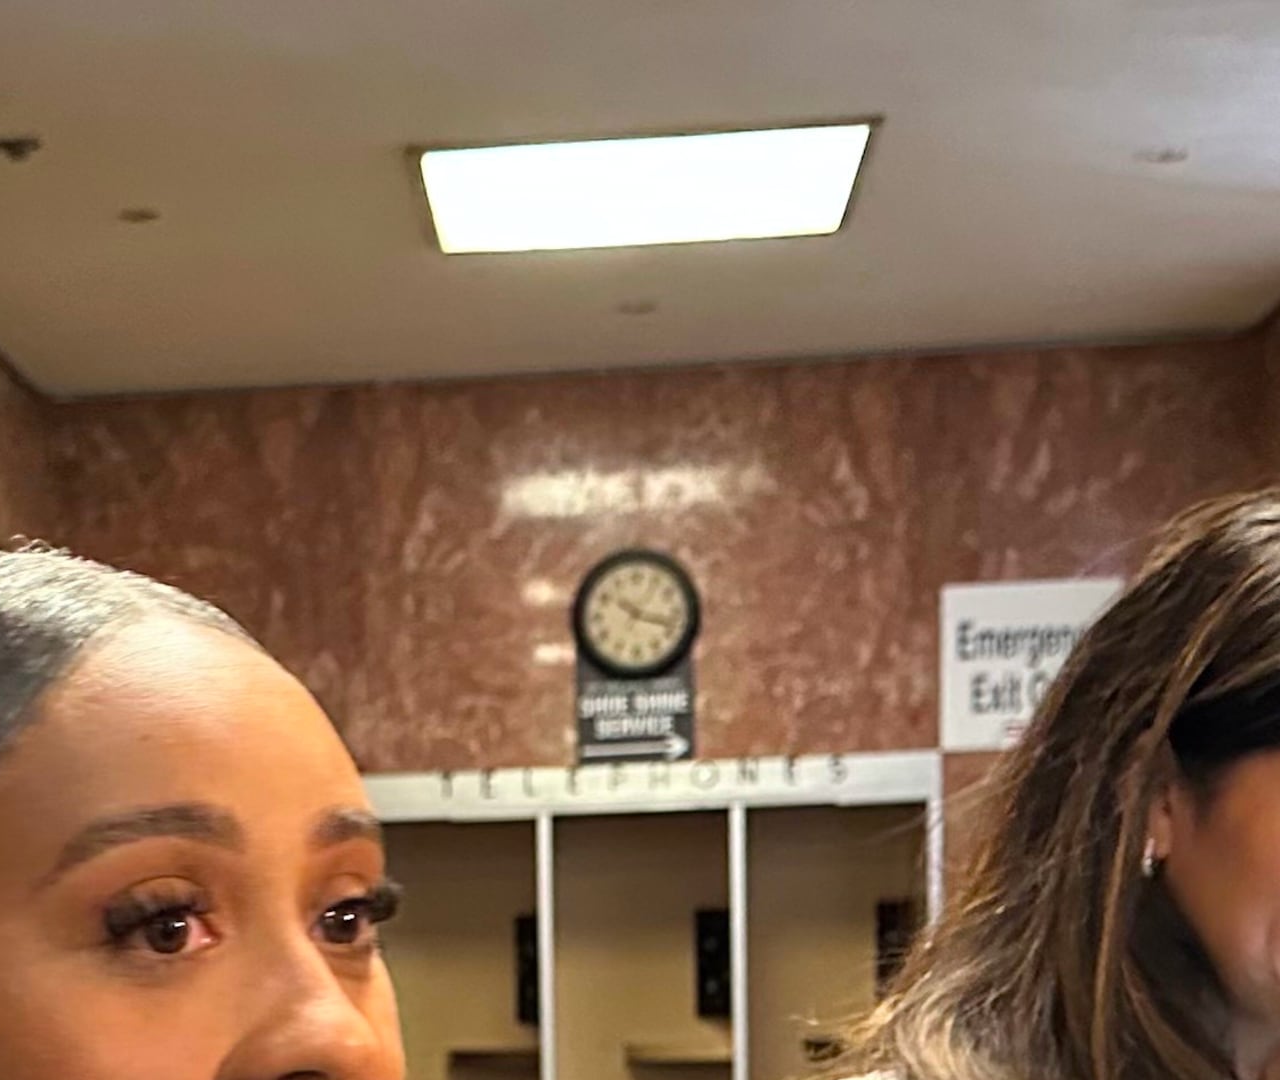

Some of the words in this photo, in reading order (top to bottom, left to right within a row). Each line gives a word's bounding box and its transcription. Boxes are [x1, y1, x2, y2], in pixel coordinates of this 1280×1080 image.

[956, 619, 1080, 667] Emergen
[970, 672, 1022, 714] Exit
[438, 757, 850, 800] TELEPHONES
